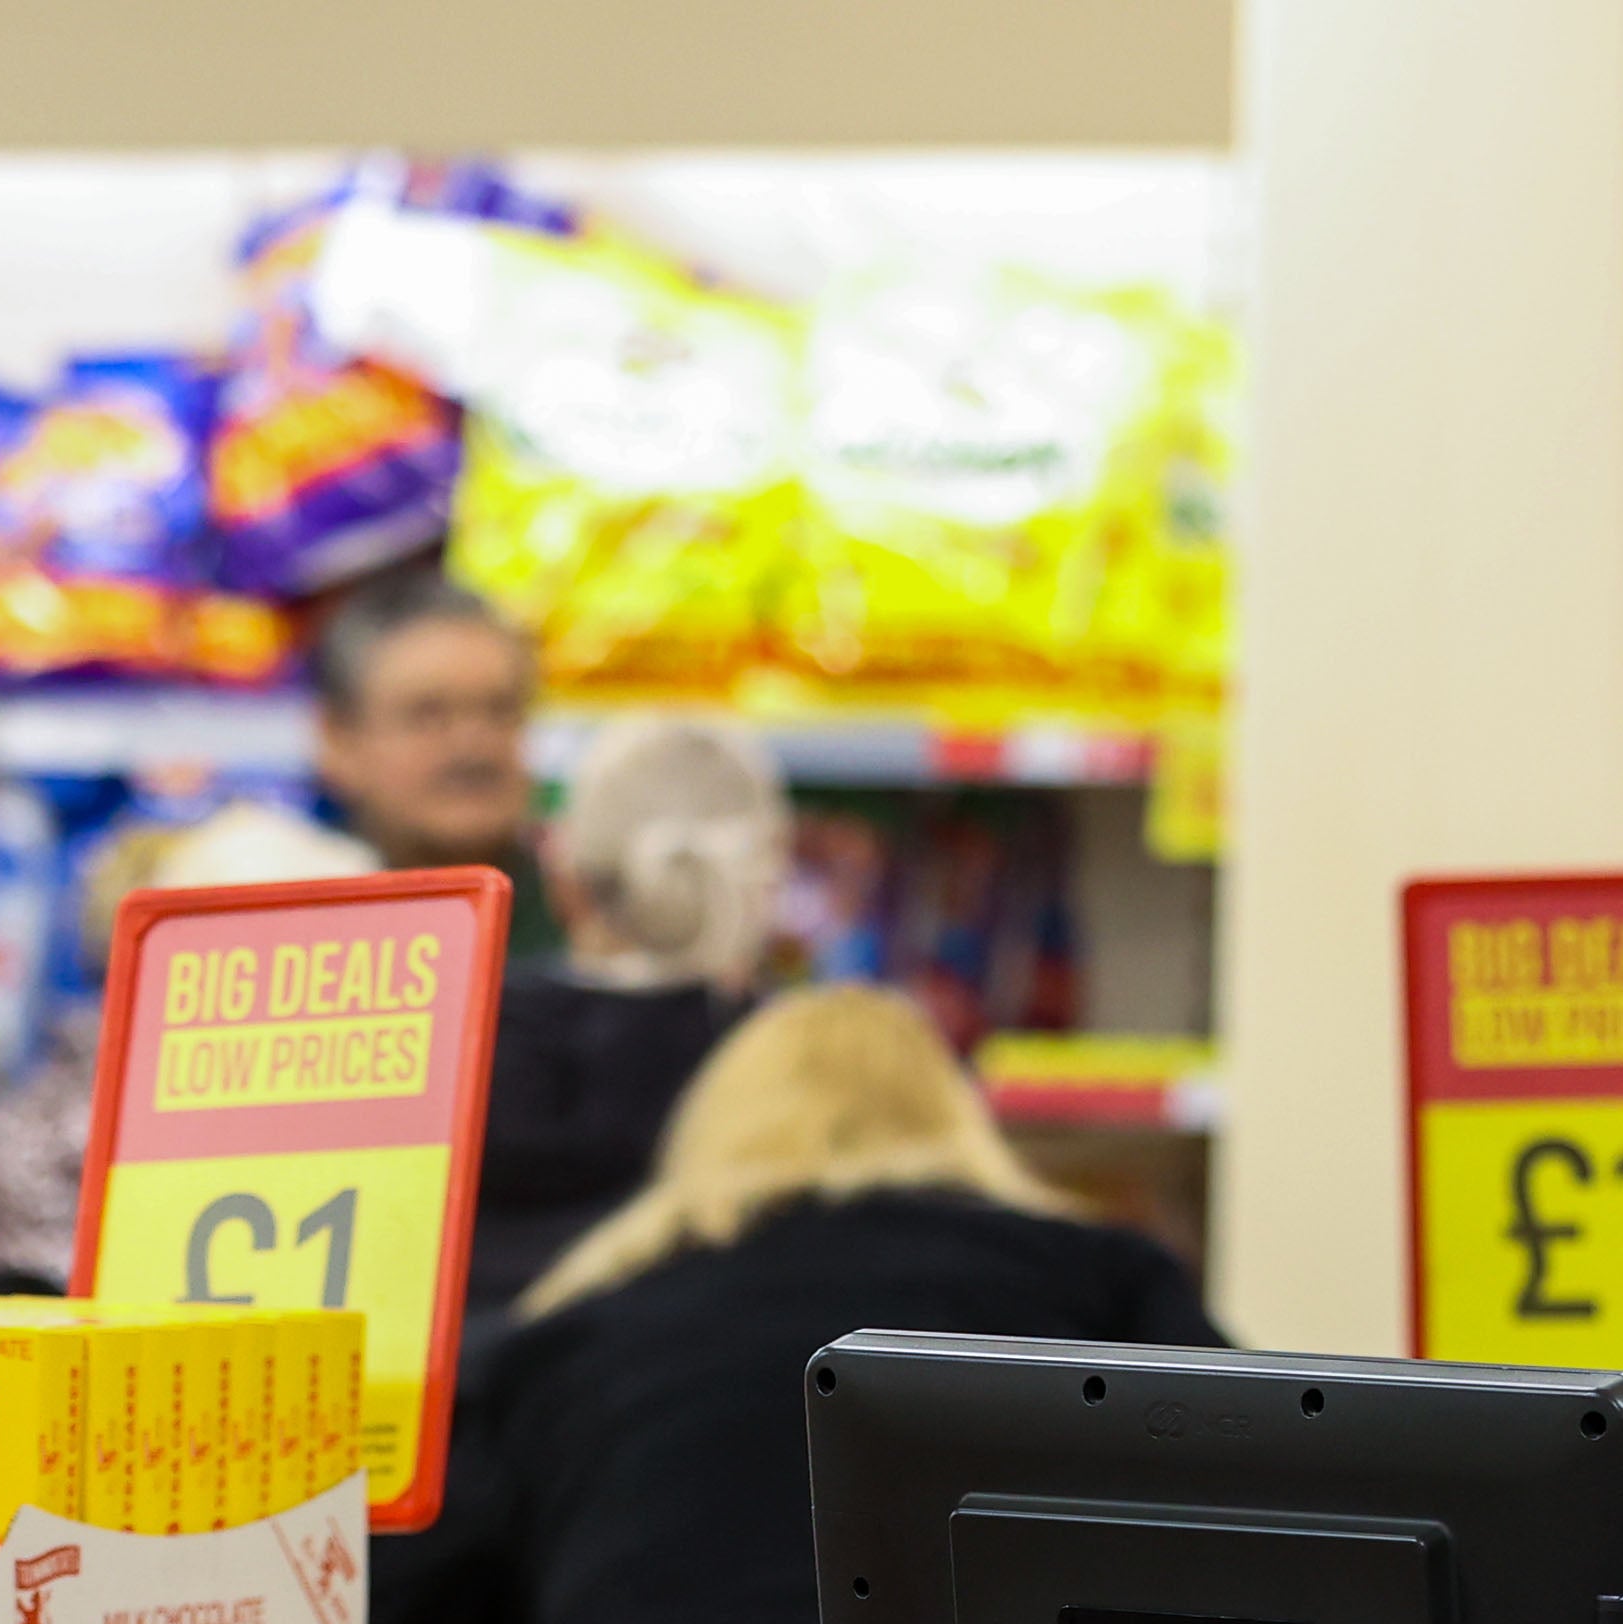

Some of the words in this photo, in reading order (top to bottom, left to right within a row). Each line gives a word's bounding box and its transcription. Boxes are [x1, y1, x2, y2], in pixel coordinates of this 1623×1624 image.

[164, 948, 259, 1027] BIG
[268, 933, 441, 1018] DEALS
[166, 1036, 262, 1099] LOW
[268, 1025, 422, 1092] PRICES
